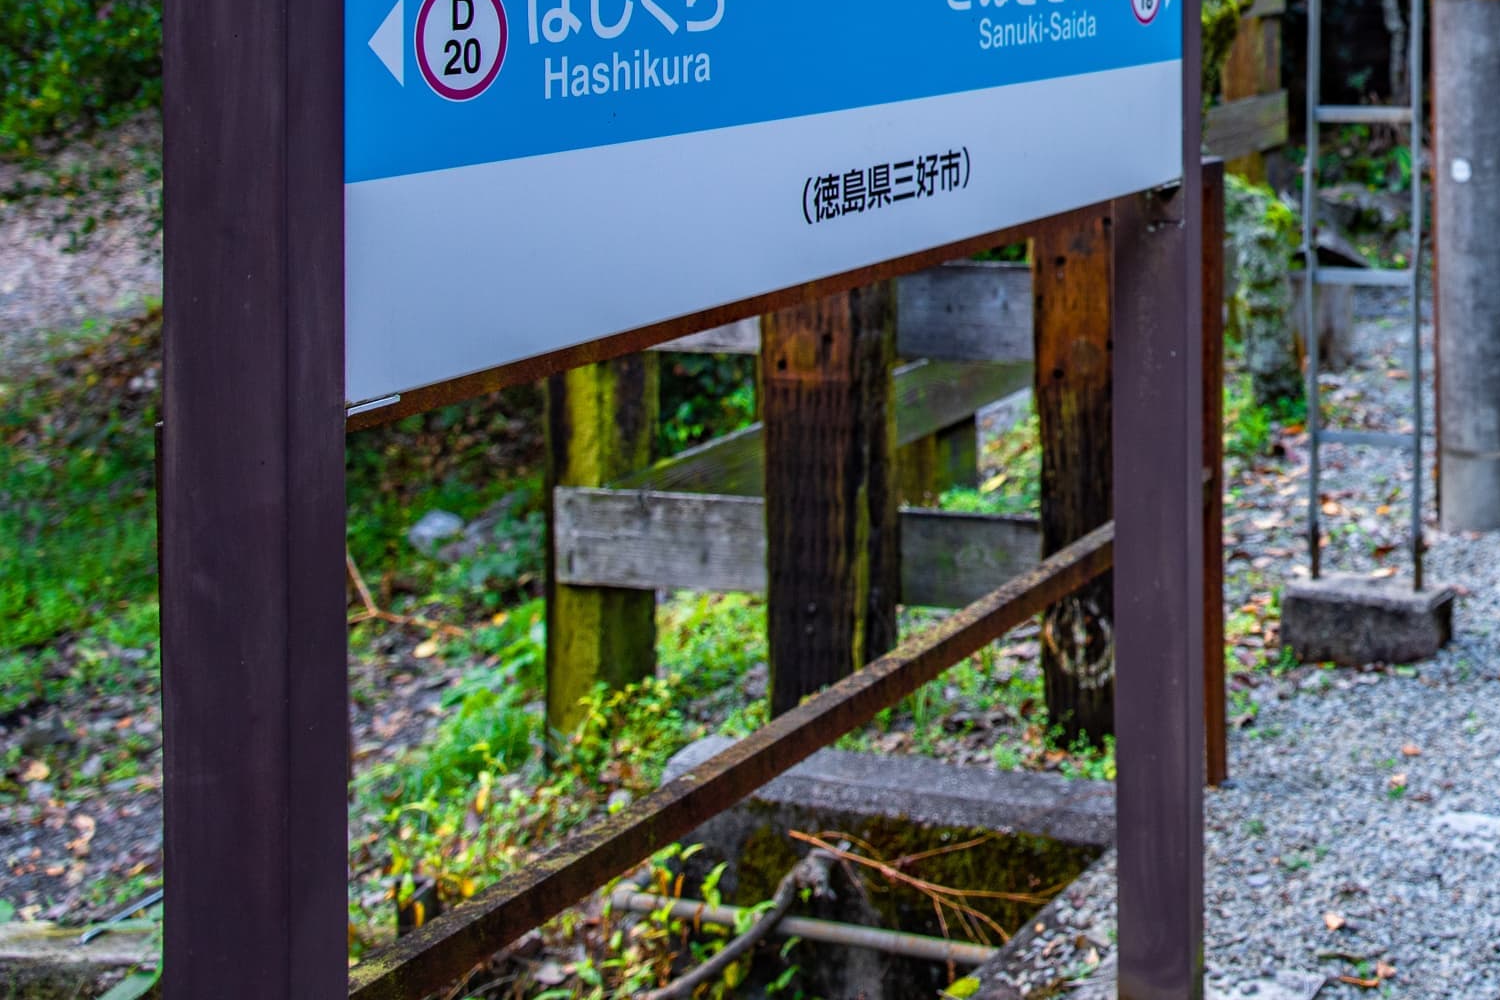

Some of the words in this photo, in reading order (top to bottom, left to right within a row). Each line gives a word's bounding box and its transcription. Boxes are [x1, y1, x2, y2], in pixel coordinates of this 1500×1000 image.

[979, 10, 1097, 50] Sanuki-Saida
[444, 37, 482, 76] 20
[544, 49, 711, 100] Hashikura
[802, 146, 971, 225] (徳島県三好市)
